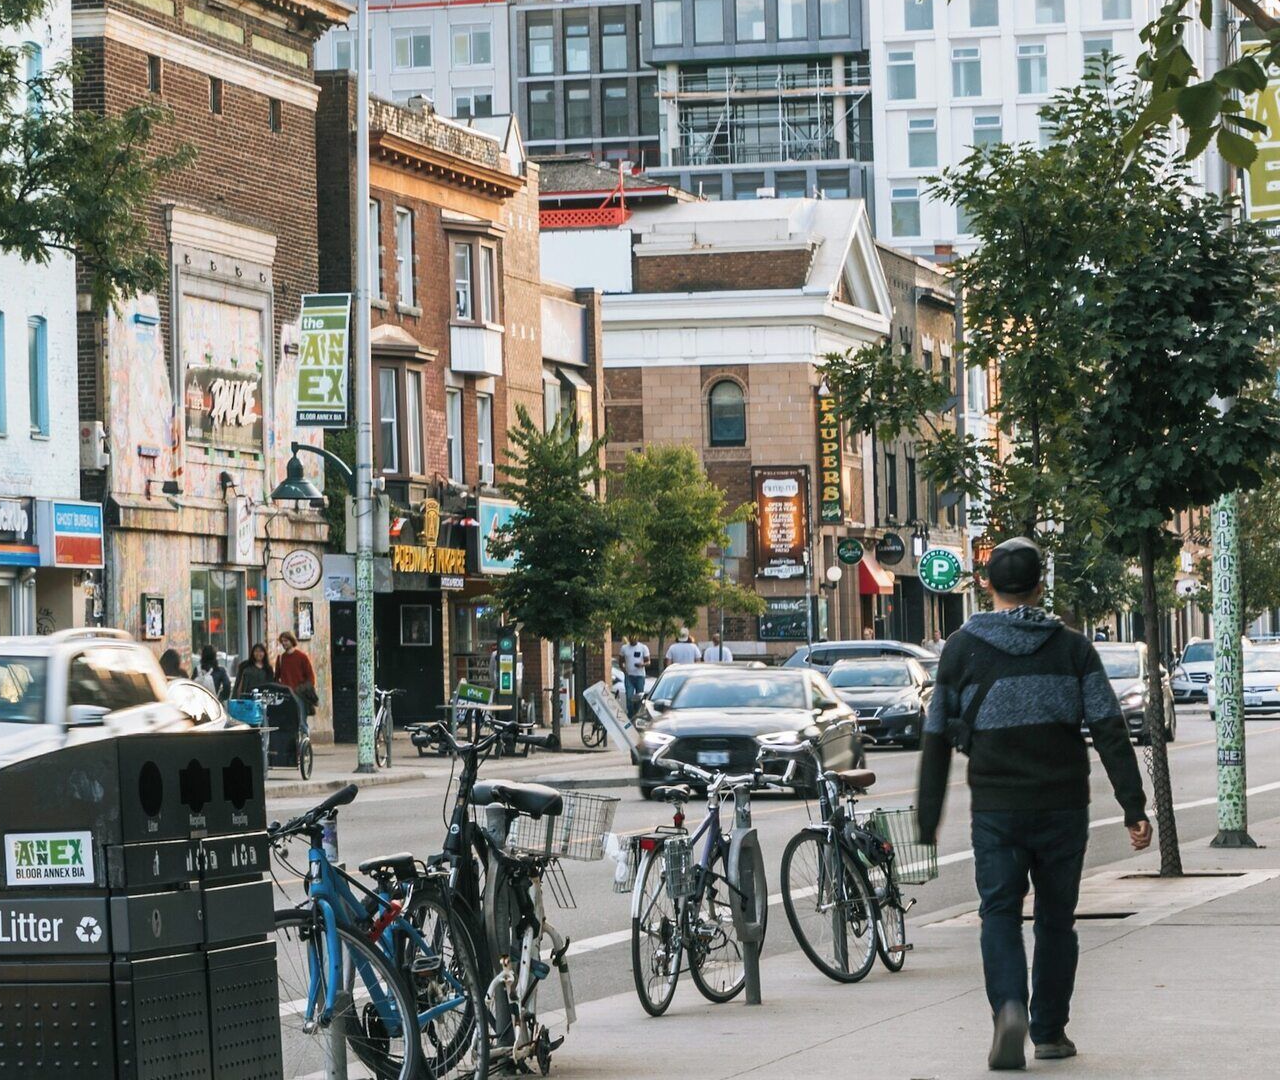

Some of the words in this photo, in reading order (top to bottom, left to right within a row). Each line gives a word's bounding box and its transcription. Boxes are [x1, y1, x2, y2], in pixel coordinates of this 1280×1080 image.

[303, 318, 324, 330] the
[299, 413, 317, 421] BLOOR
[317, 413, 333, 421] ANNEX
[334, 413, 343, 421] BIA
[933, 560, 949, 579] P
[1218, 510, 1231, 616] BLOOR
[1222, 633, 1234, 738] ANNEX
[15, 839, 83, 866] ANNEX
[16, 868, 42, 879] BLOOR
[44, 867, 71, 878] ANNEX
[72, 866, 85, 877] BIA
